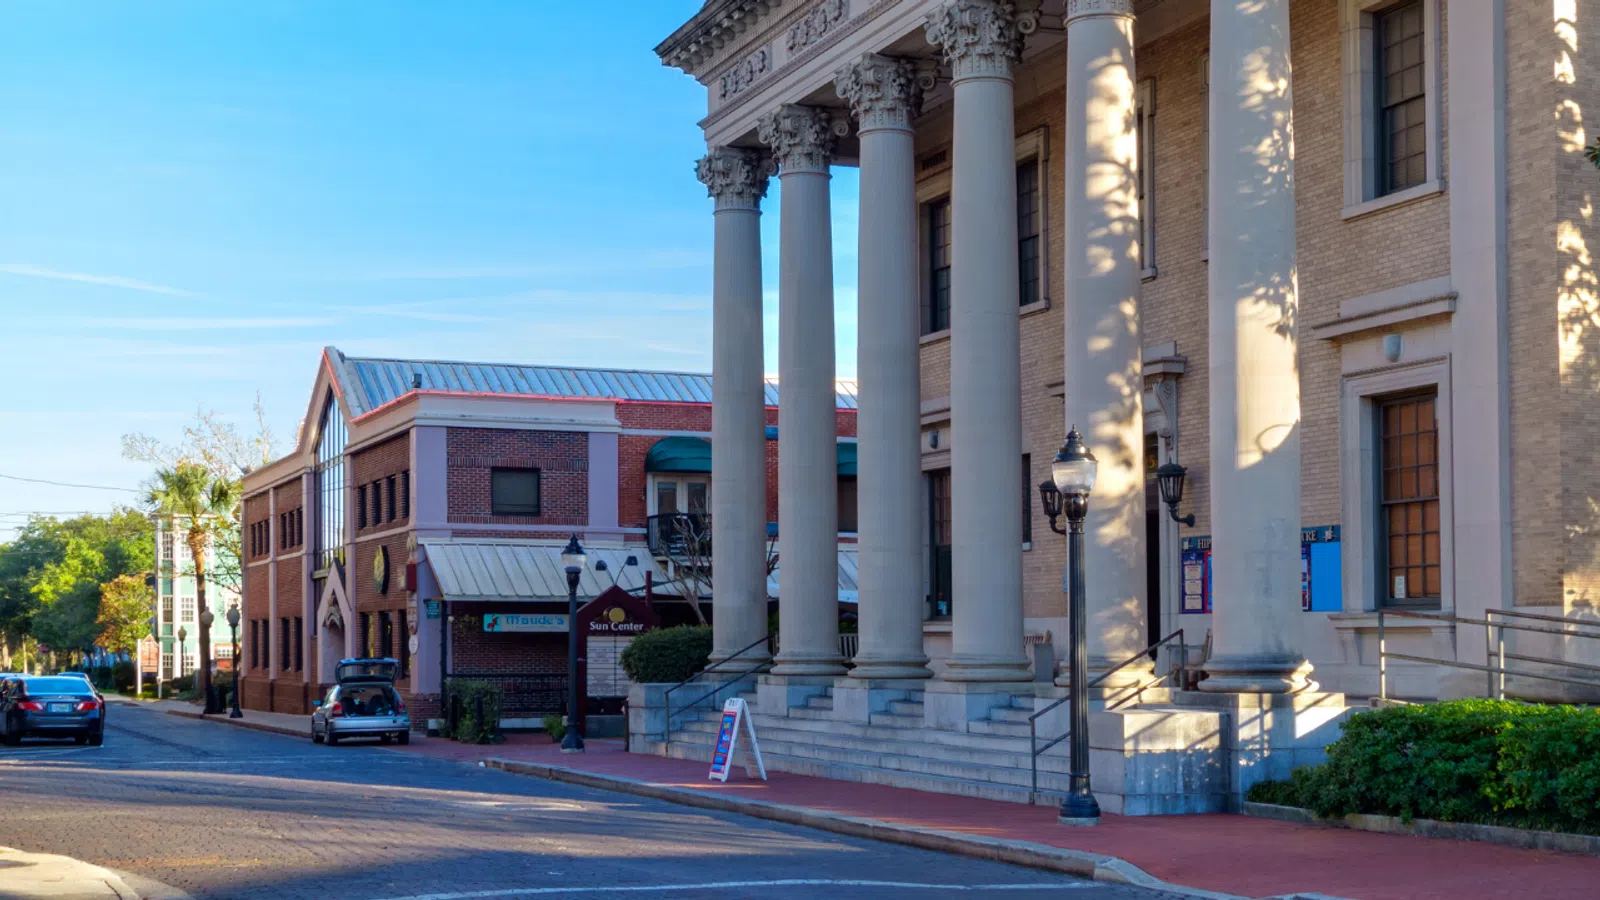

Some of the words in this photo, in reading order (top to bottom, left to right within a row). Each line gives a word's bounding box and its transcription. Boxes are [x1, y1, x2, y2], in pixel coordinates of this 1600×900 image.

[505, 615, 564, 625] Maude's
[589, 621, 608, 631] Sun
[610, 621, 644, 631] Center
